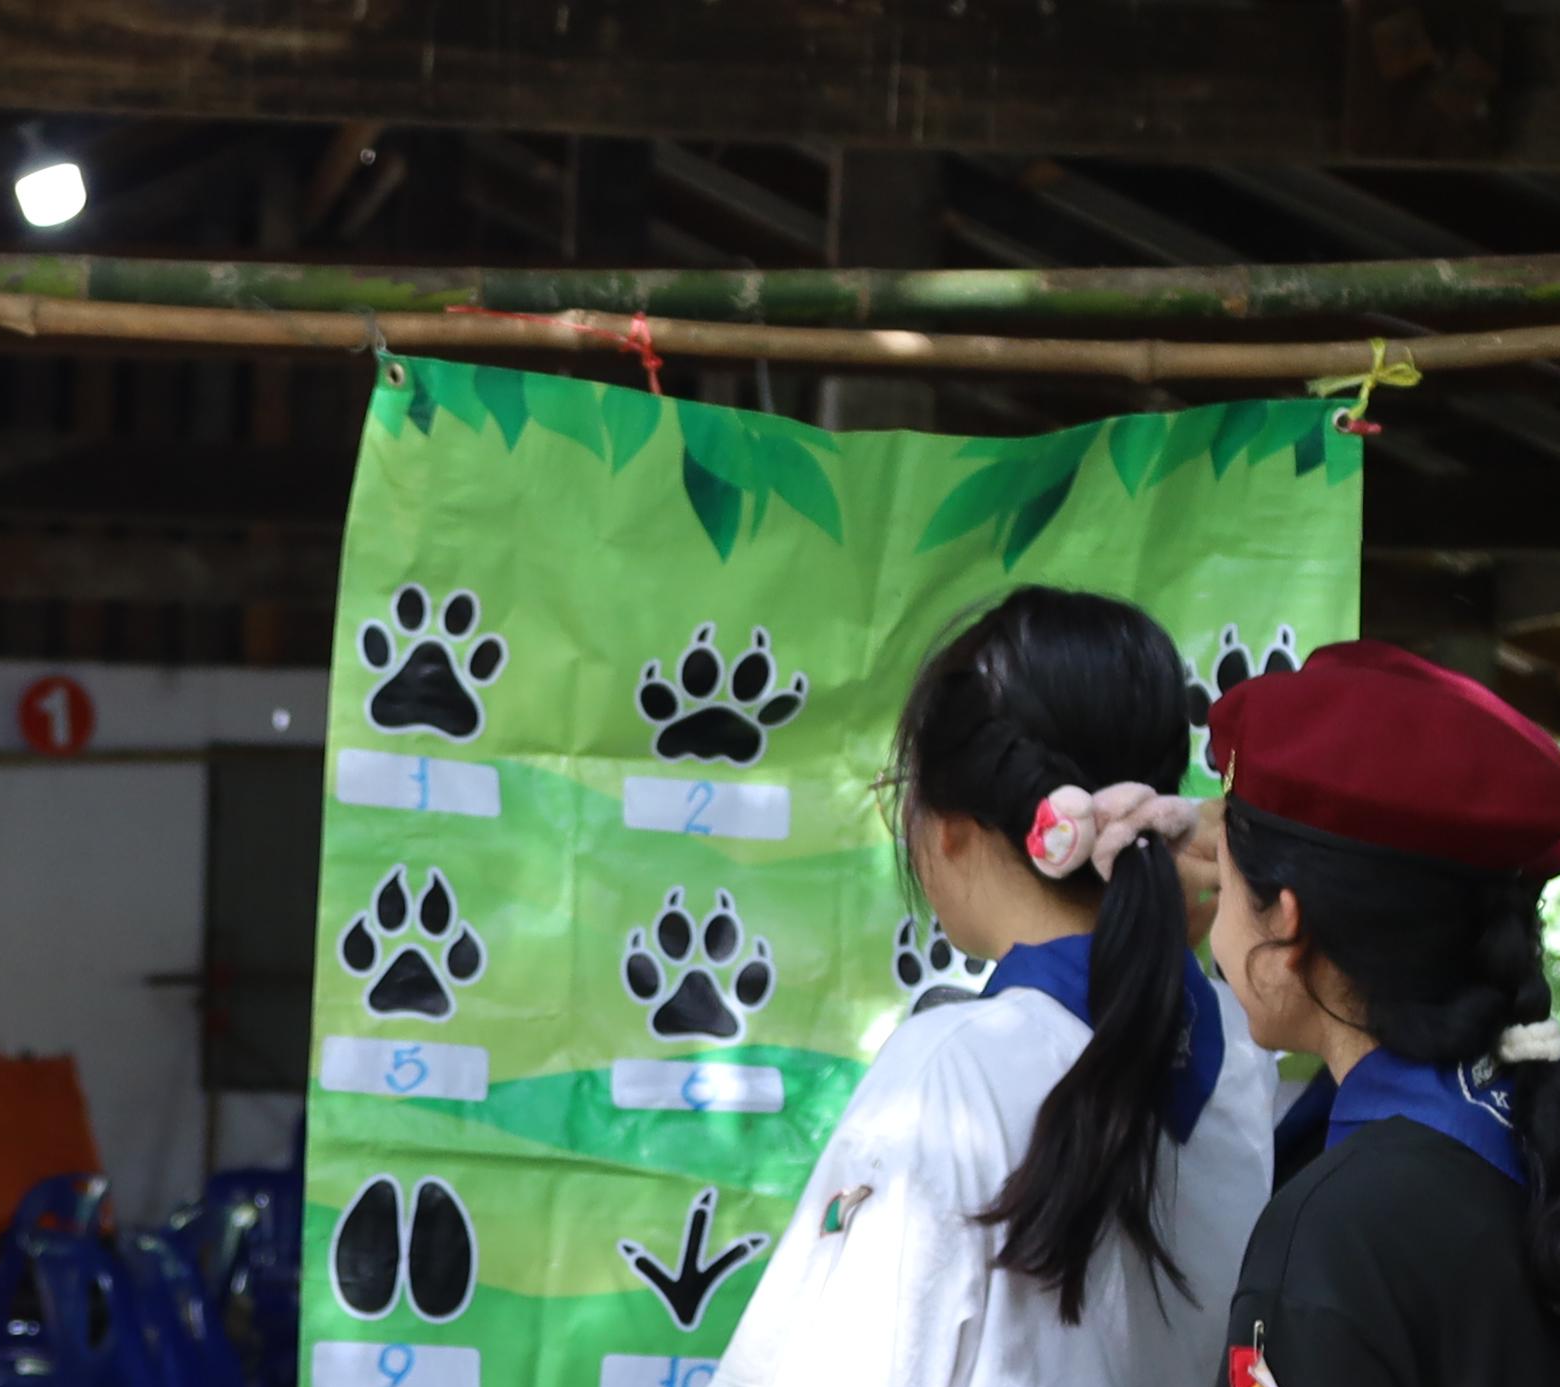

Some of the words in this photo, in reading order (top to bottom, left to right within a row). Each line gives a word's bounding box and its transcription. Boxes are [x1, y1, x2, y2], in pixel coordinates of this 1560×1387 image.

[38, 684, 71, 748] 1
[408, 756, 430, 811] 1
[683, 780, 715, 836] 2
[385, 1045, 429, 1093] 5
